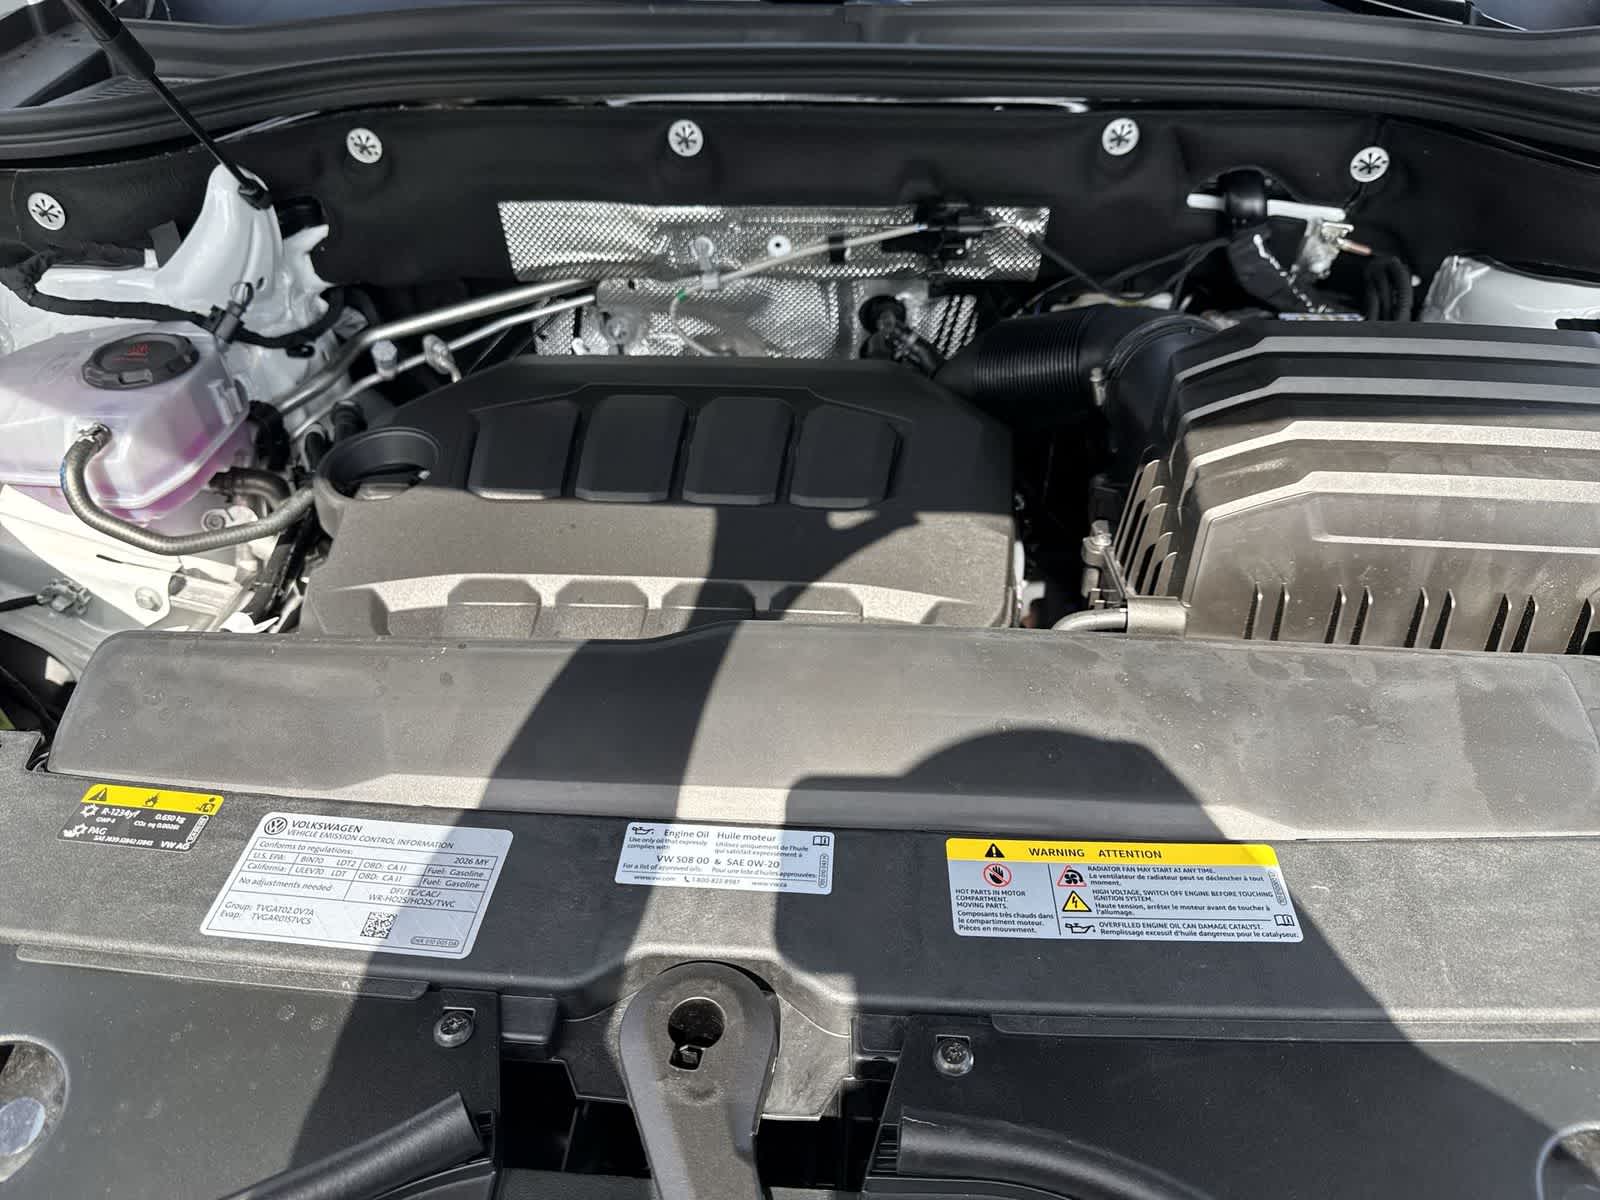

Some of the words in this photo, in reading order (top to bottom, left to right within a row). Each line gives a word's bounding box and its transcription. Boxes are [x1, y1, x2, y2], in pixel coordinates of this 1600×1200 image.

[101, 807, 141, 819] R-1234yf
[87, 827, 108, 836] PAG
[292, 820, 363, 833] VOLKSWAGEN
[287, 829, 319, 838] VEHICLE
[320, 832, 358, 841] EMISSION
[359, 835, 395, 845] CONTROL
[398, 839, 454, 849] INFORMATION
[664, 829, 695, 839] Engine
[696, 831, 709, 839] Oil
[717, 831, 741, 840] Huile
[742, 833, 776, 842] moteur
[160, 841, 176, 849] VW
[176, 842, 190, 850] AG
[259, 840, 297, 849] Conforms
[307, 845, 353, 855] regulations:
[269, 853, 286, 861] EPA:
[1028, 847, 1085, 857] WARNING
[1098, 849, 1162, 859] ATTENTION
[301, 855, 324, 864] BIN70
[336, 859, 356, 868] LDT2
[454, 856, 473, 865] 2026
[475, 858, 489, 866] MY
[657, 855, 675, 863] VW
[676, 856, 694, 864] 508
[726, 858, 745, 867] SAE
[747, 859, 780, 868] 0W-20
[247, 862, 287, 873] California:
[295, 866, 324, 876] ULEV70
[331, 869, 348, 878] LDT
[363, 861, 384, 870] OBD:
[387, 863, 399, 871] CA
[358, 872, 378, 881] OBD:
[382, 874, 394, 882] CA
[427, 867, 447, 875] Fuel:
[450, 868, 485, 878] Gasoline
[239, 877, 251, 885] No
[251, 878, 301, 889] adjustments
[302, 882, 333, 892] needed
[422, 877, 441, 886] Fuel:
[445, 879, 480, 889] Gasoline
[224, 901, 252, 912] Group:
[1117, 902, 1146, 910] tension,
[220, 910, 241, 920] Evap:
[957, 910, 999, 918] Composants
[966, 918, 1015, 926] compartiment
[1100, 929, 1144, 937] Remplissage
